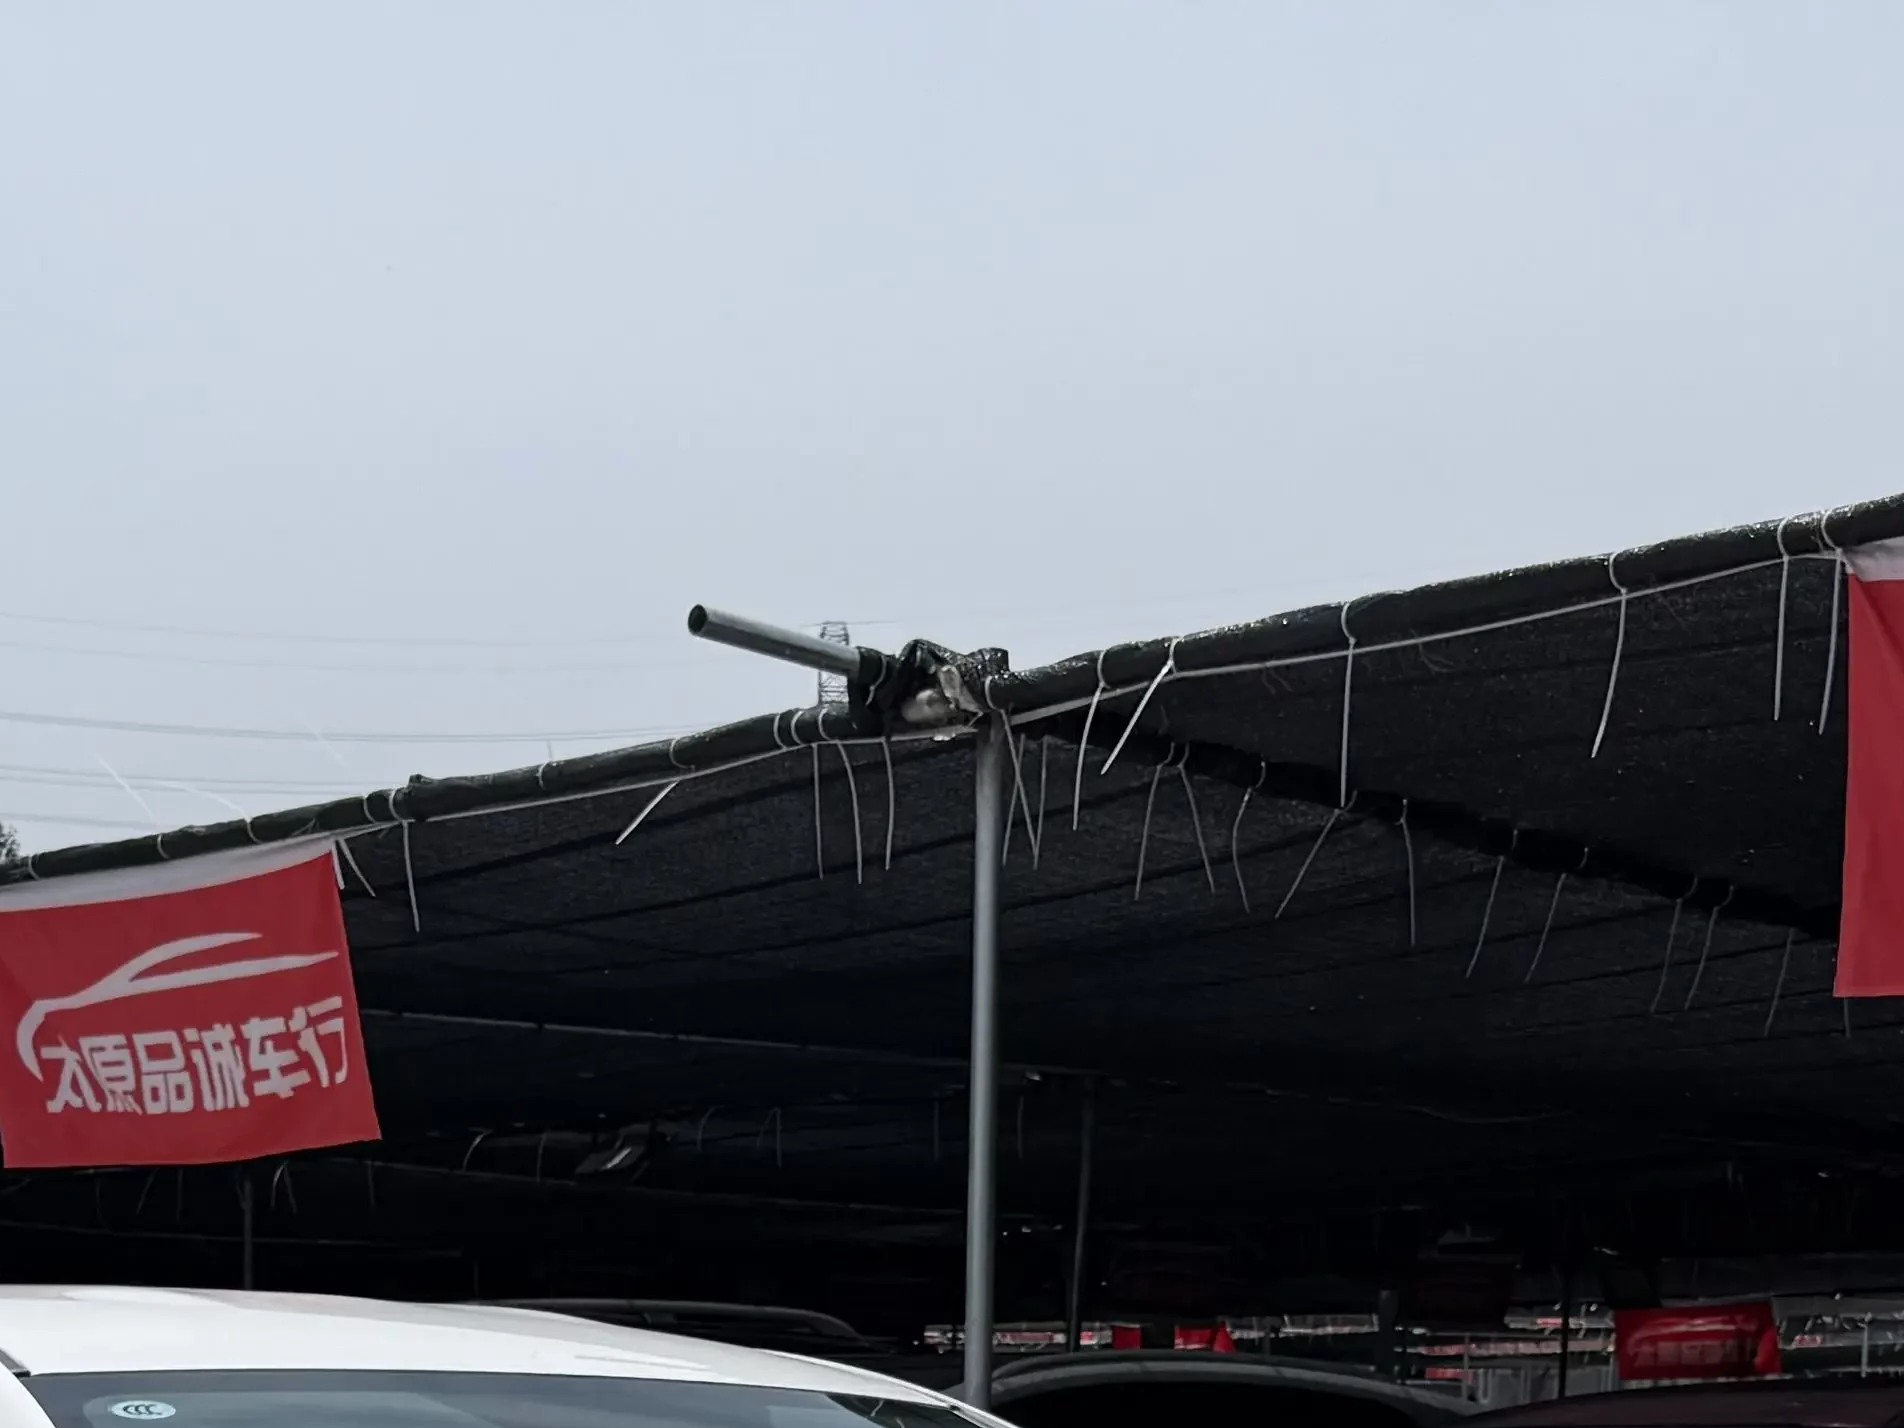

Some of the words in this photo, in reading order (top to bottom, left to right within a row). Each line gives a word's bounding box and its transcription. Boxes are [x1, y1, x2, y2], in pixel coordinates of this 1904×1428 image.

[40, 995, 352, 1116] 太原品诚车行
